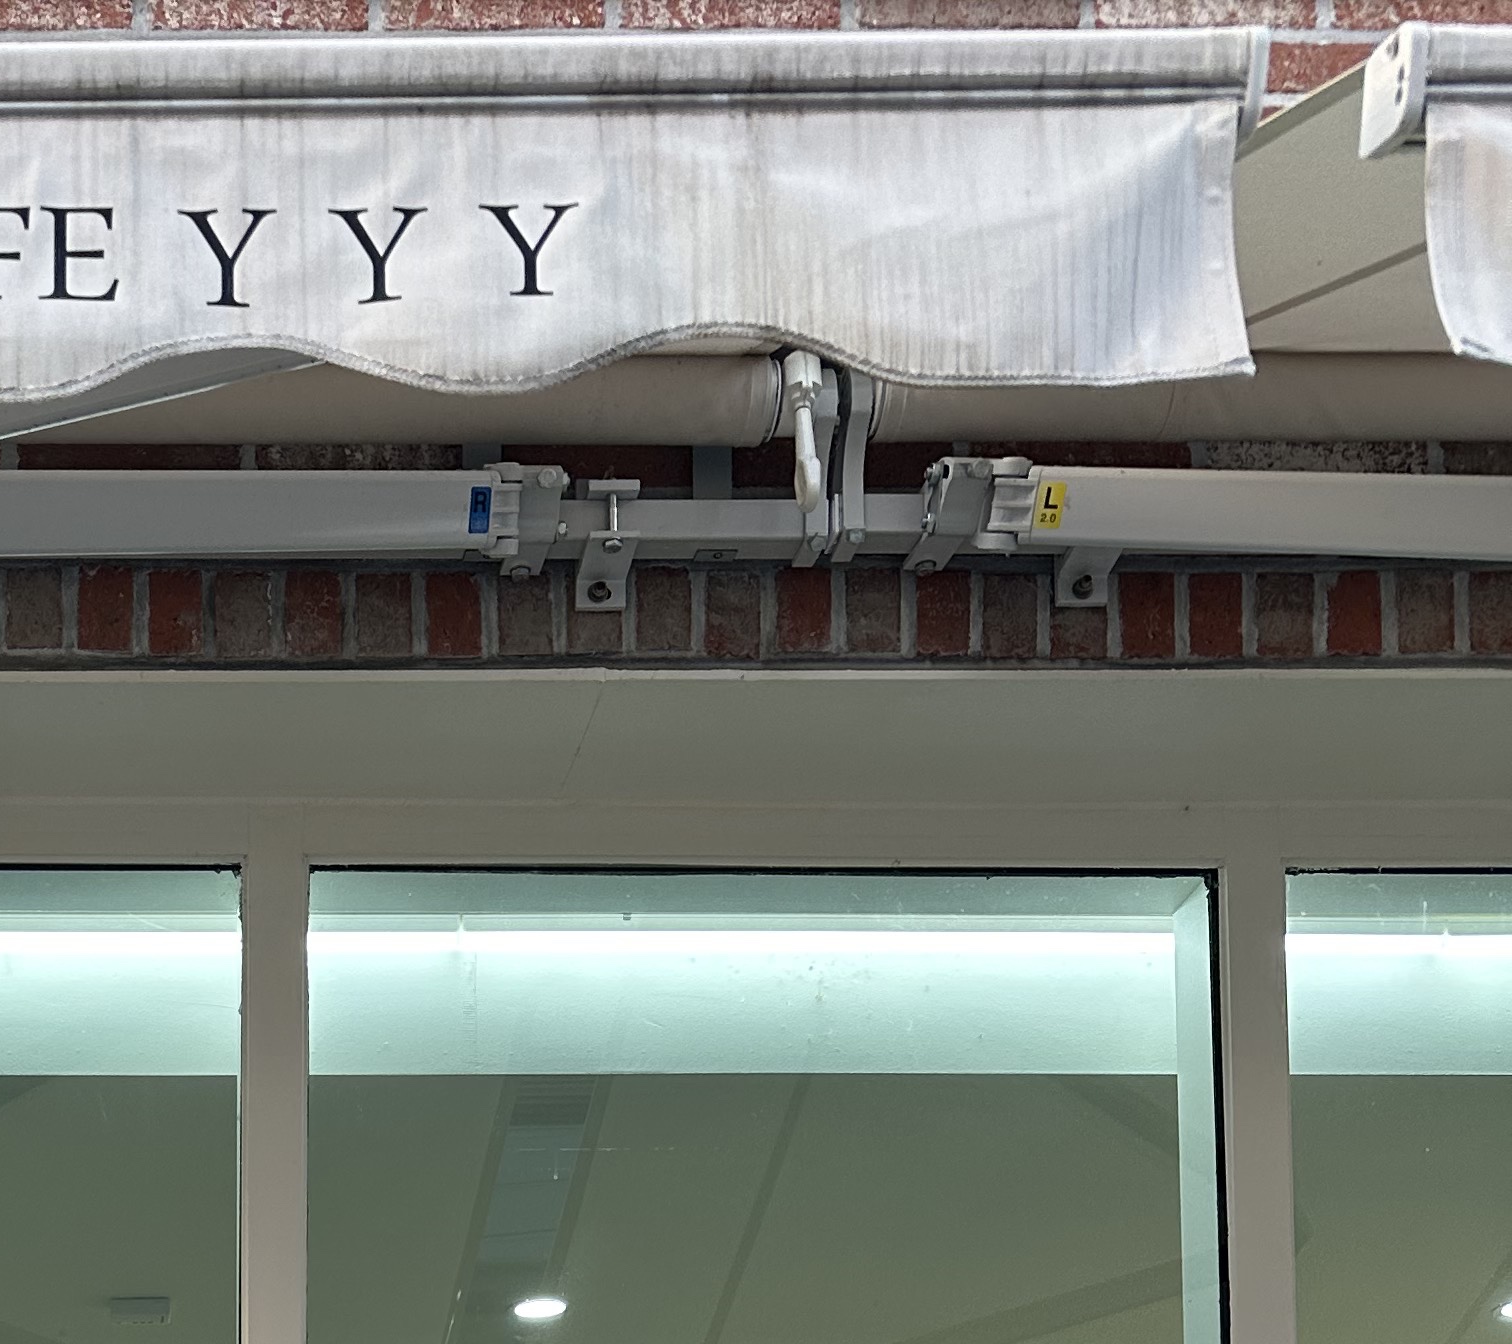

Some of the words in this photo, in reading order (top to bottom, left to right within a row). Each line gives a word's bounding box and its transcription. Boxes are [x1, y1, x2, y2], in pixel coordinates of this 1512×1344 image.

[177, 208, 277, 308] Y
[328, 206, 428, 305] Y
[478, 202, 579, 297] Y
[474, 491, 487, 513] R
[1043, 486, 1059, 510] L
